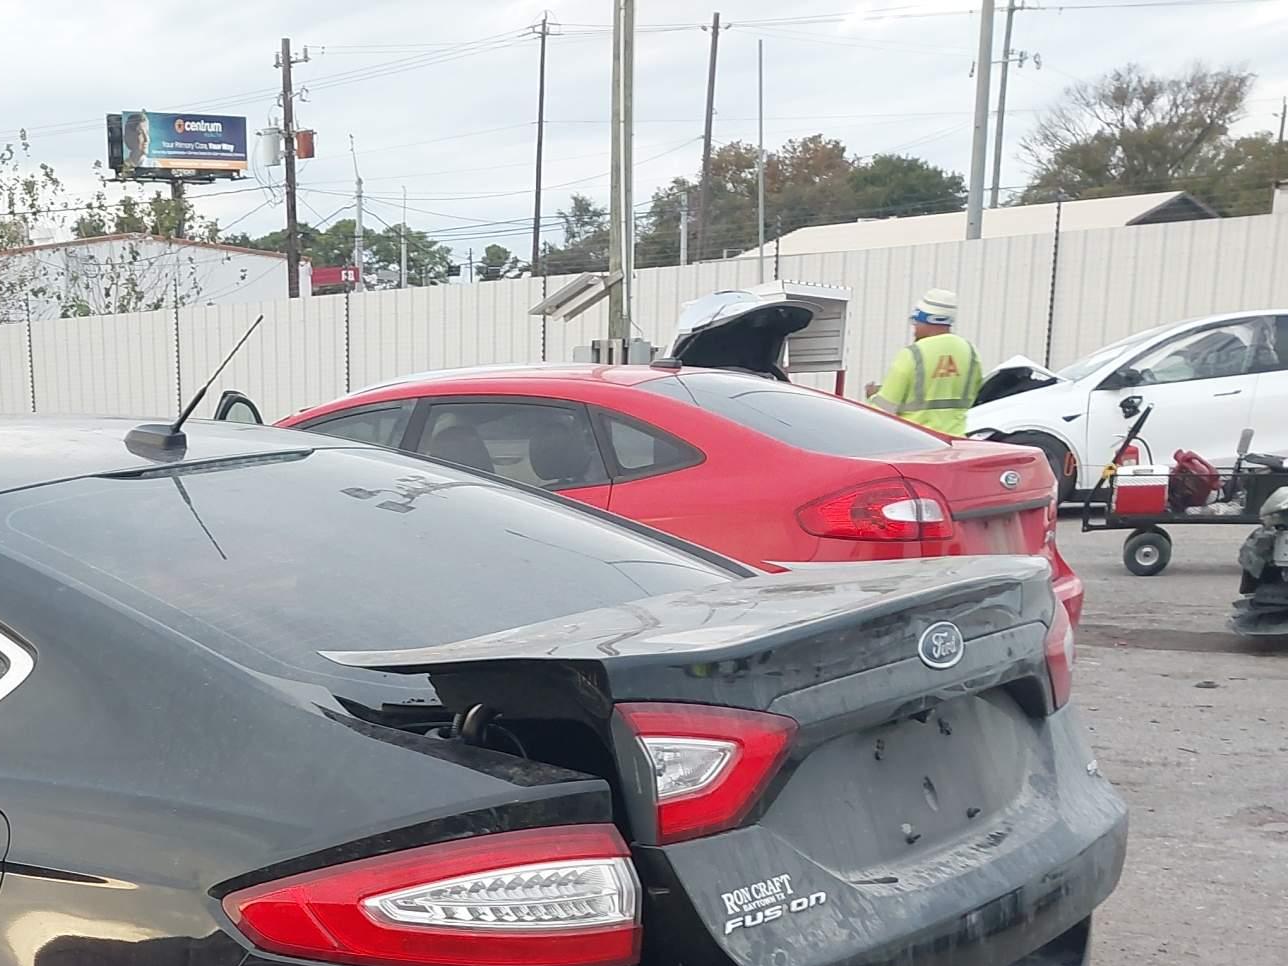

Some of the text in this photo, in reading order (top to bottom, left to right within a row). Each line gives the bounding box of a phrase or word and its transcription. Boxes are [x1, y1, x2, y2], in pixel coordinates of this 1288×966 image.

[185, 120, 222, 132] centrum
[175, 141, 194, 150] Primary
[208, 143, 221, 151] Your
[221, 143, 234, 152] Way
[721, 873, 794, 915] RON CRAFT
[742, 896, 777, 912] BAYTOWN
